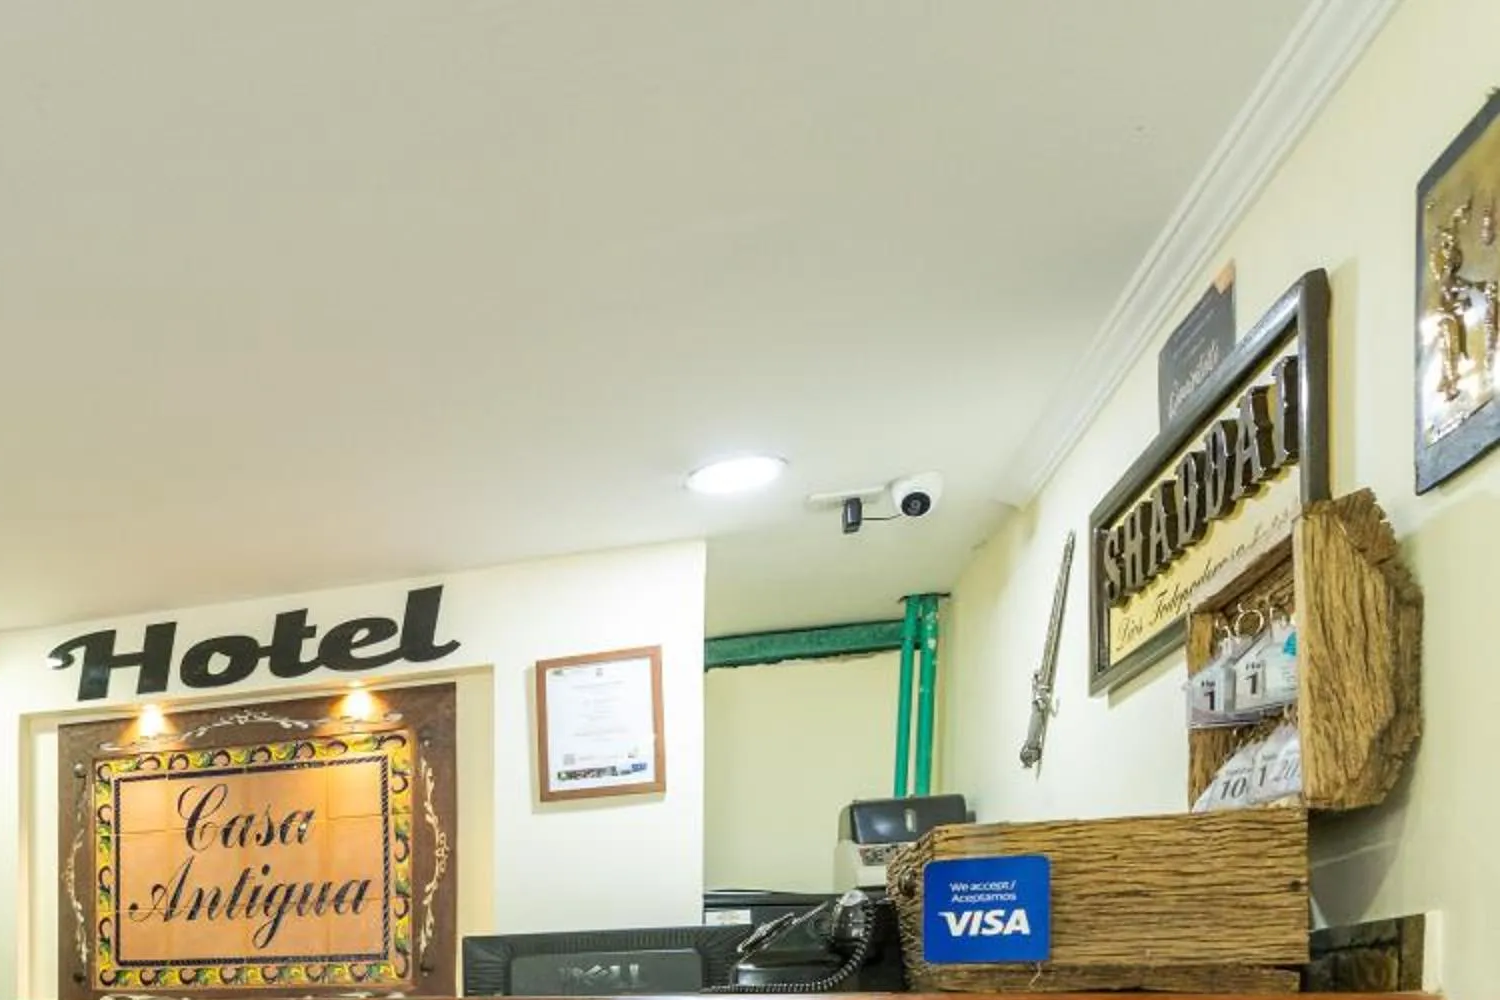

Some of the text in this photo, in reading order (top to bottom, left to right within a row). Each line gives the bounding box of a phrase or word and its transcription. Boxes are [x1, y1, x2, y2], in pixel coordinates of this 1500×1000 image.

[1103, 356, 1300, 607] SHADDAI
[47, 584, 460, 701] Hotel
[177, 783, 316, 854] Casa
[129, 856, 373, 950] Antigua
[937, 908, 1031, 937] VISA
[949, 882, 969, 893] We
[951, 893, 1017, 903] Aceptamos
